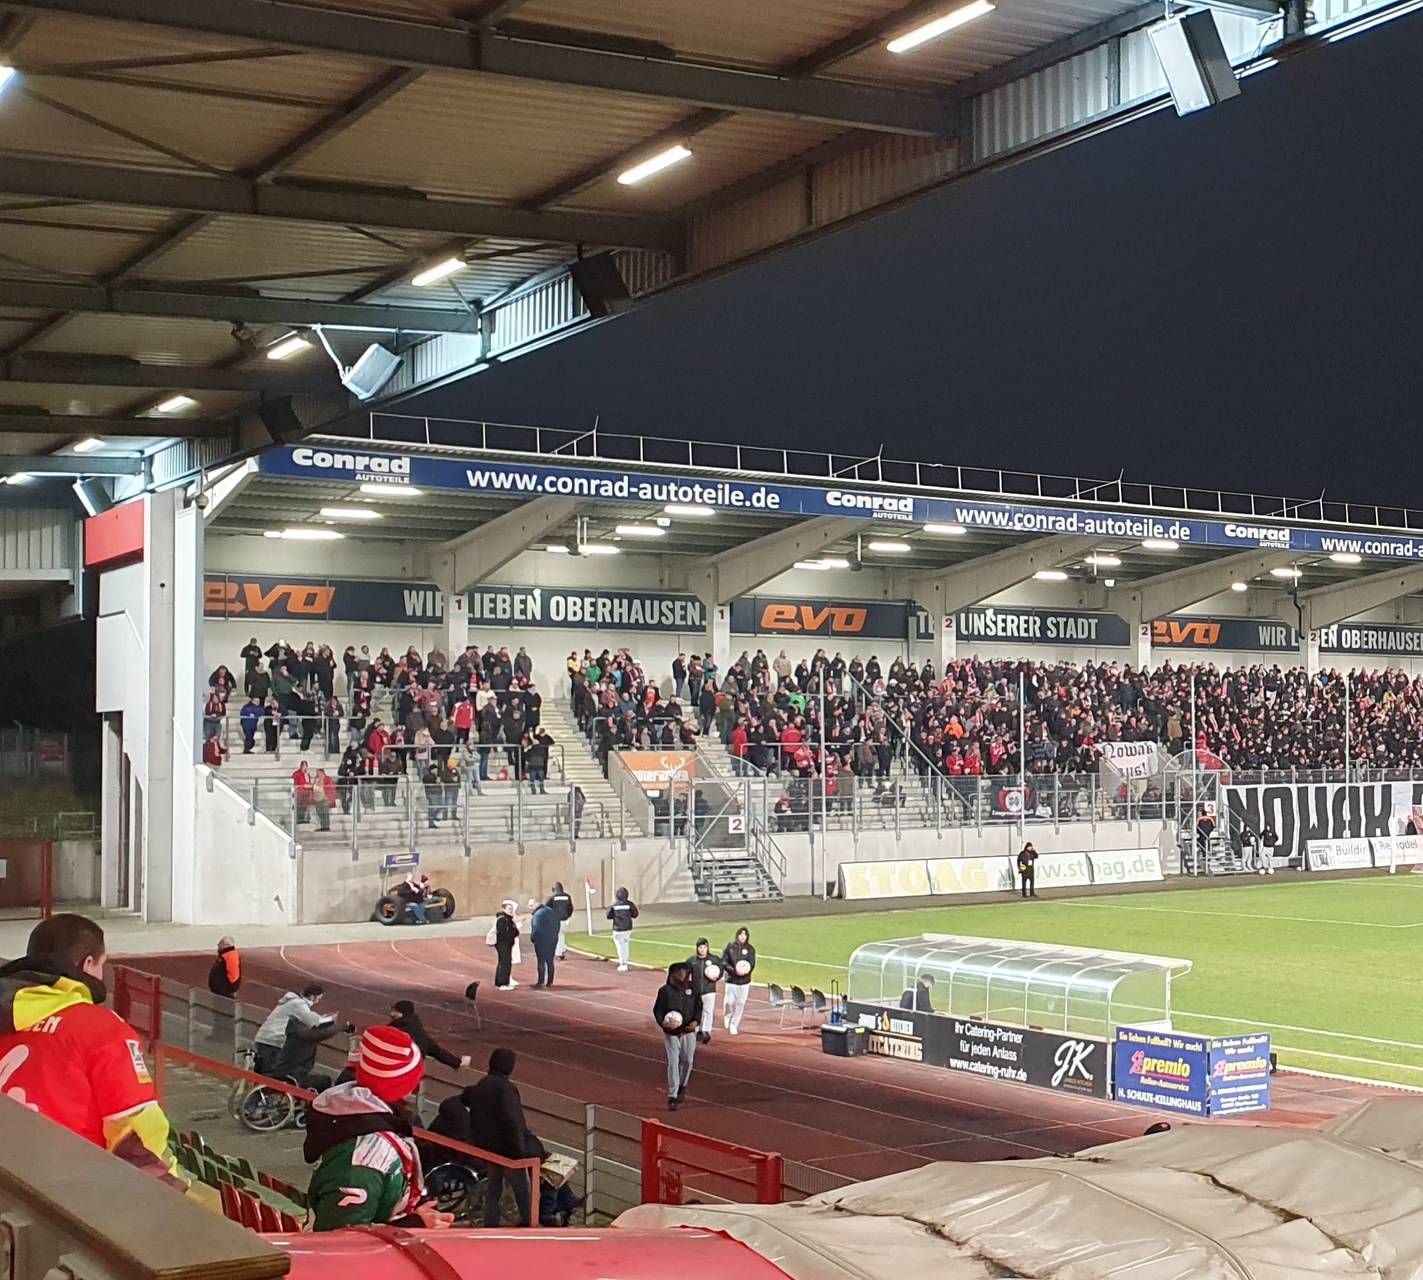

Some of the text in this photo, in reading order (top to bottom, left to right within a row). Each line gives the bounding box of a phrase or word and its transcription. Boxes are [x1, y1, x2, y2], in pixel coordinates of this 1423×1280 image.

[292, 449, 410, 474] Conrad
[355, 474, 410, 484] AUTOTEILE
[466, 469, 780, 509] www.conrad-autoteile.de
[826, 491, 914, 512] Conrad
[873, 512, 913, 521] AUTOTEILE
[955, 508, 1191, 541] www.conrad-autoteile.de
[1224, 525, 1290, 541] Conrad
[204, 581, 336, 615] evo
[550, 595, 707, 626] OBERHAUSEN.
[760, 604, 868, 632] evo
[945, 618, 953, 628] 2
[960, 611, 1041, 638] UNSERER
[1047, 618, 1098, 640] STADT
[1141, 627, 1148, 636] 2
[1259, 625, 1286, 646] WIR
[1310, 632, 1317, 642] 2
[1206, 803, 1214, 814] 3
[732, 818, 743, 831] 2
[1227, 784, 1393, 857] NOWAK
[850, 859, 989, 896] STOAG
[954, 1021, 1024, 1044] Ihr Catering-Partner
[960, 1040, 1017, 1061] für jeden Anlass
[1173, 1039, 1184, 1049] Wir
[1185, 1041, 1202, 1052] auch!
[949, 1057, 1028, 1082] www.catering-ruhr.de
[1143, 1057, 1190, 1077] premio
[1225, 1057, 1267, 1074] premio
[1118, 1087, 1126, 1097] H.
[1127, 1089, 1202, 1111] SCHULTE-KELLINGHAUS
